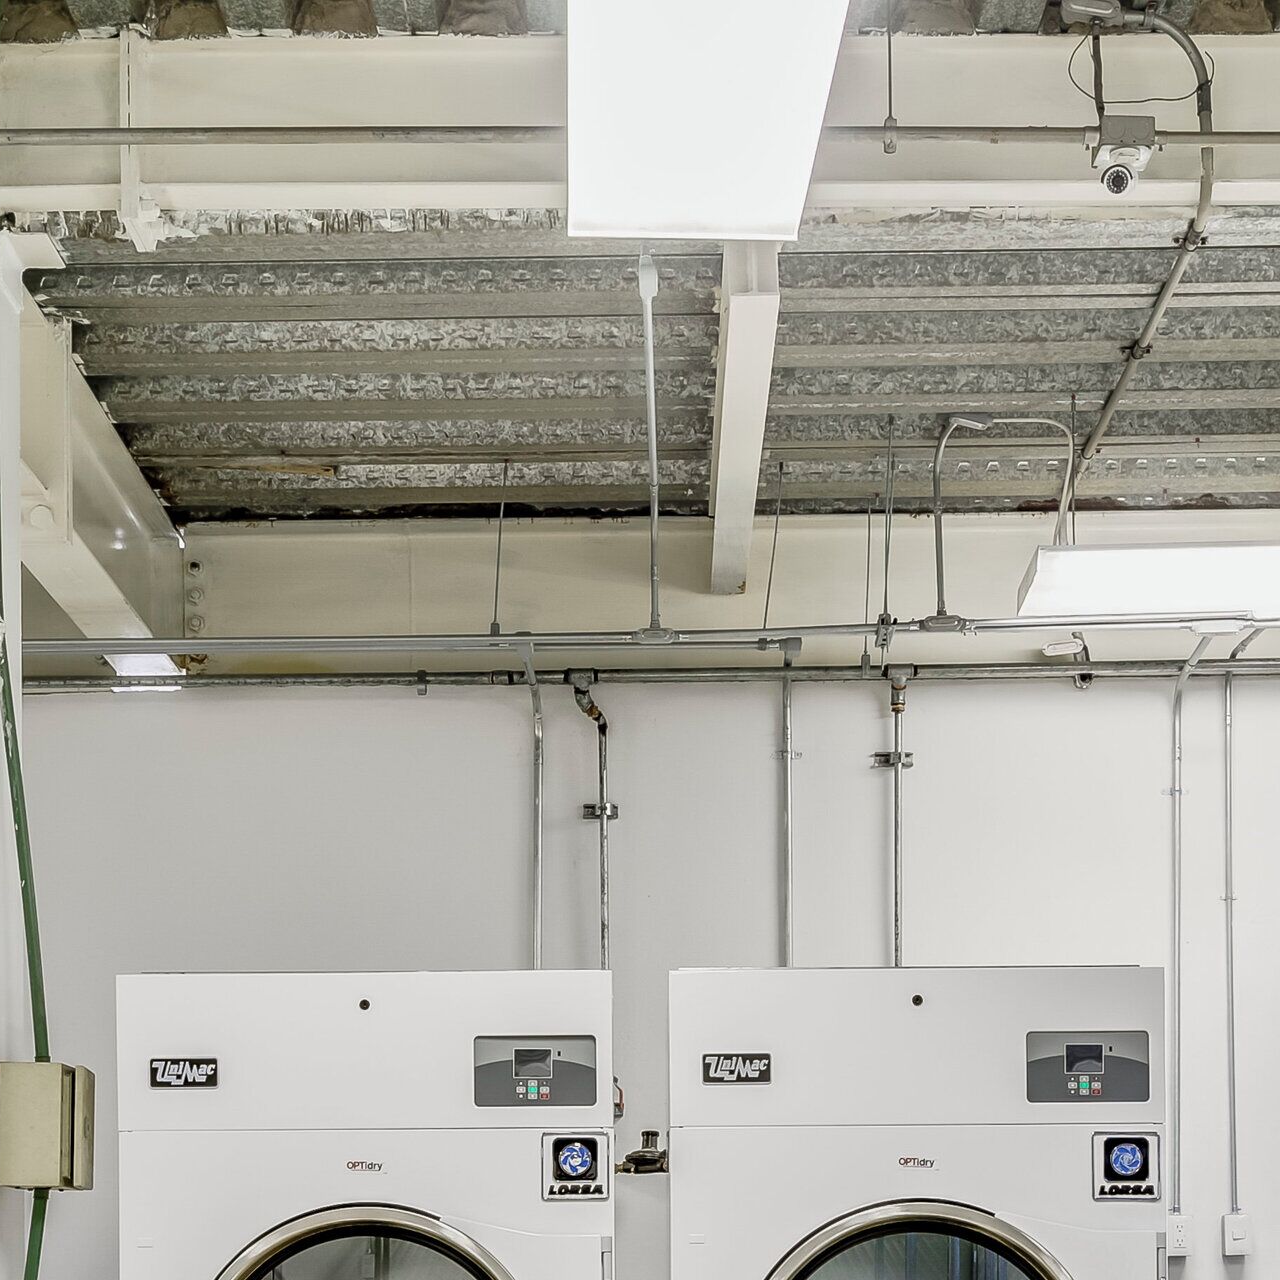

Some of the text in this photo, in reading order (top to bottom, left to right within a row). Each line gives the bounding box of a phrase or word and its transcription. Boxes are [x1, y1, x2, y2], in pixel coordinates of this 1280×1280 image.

[152, 1061, 216, 1084] UniMac
[705, 1056, 769, 1080] UniMac
[548, 1184, 604, 1195] LORSA
